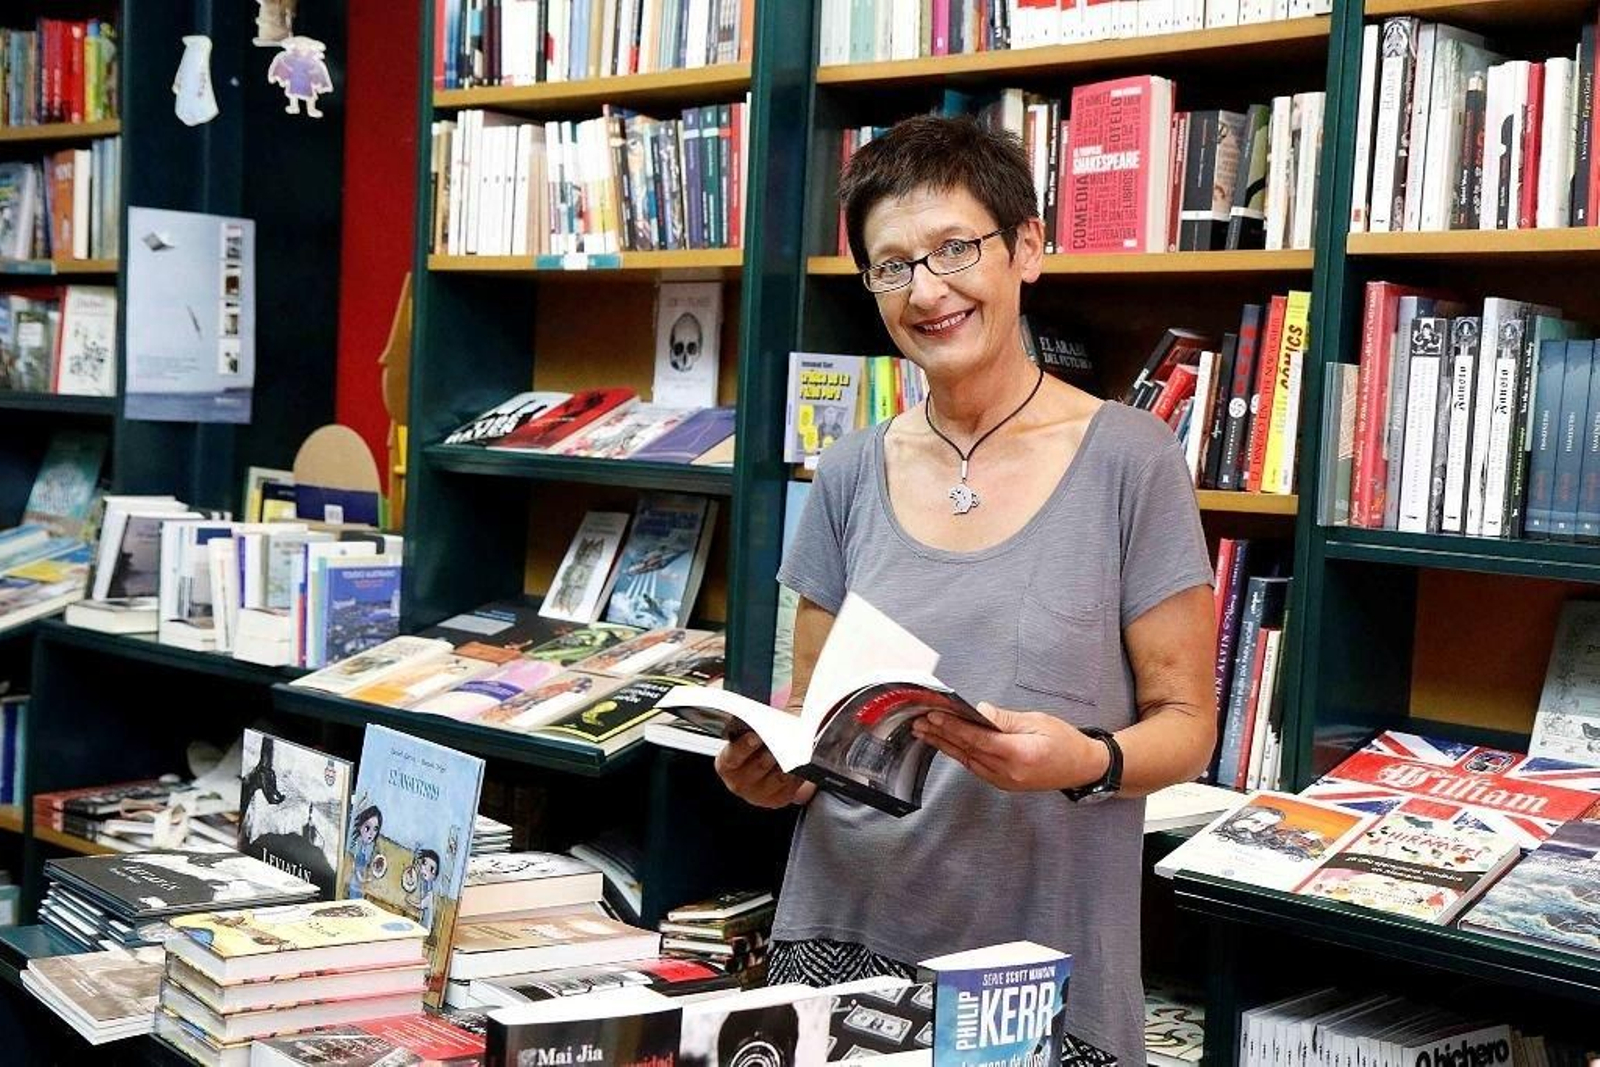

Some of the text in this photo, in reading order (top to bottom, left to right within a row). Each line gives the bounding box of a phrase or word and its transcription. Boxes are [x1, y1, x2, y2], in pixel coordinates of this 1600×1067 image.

[1109, 97, 1122, 142] OTELO
[1073, 150, 1140, 175] SHAKESPEARE
[1073, 174, 1089, 249] COMEDIA
[1219, 633, 1230, 673] ALVIN
[1376, 763, 1550, 813] William
[983, 972, 1004, 987] SERIE
[956, 991, 979, 1050] PHILIP
[980, 981, 1056, 1048] KERR
[537, 1047, 573, 1066] Mai
[576, 1045, 603, 1063] Jia
[1434, 1039, 1510, 1067] bichero
